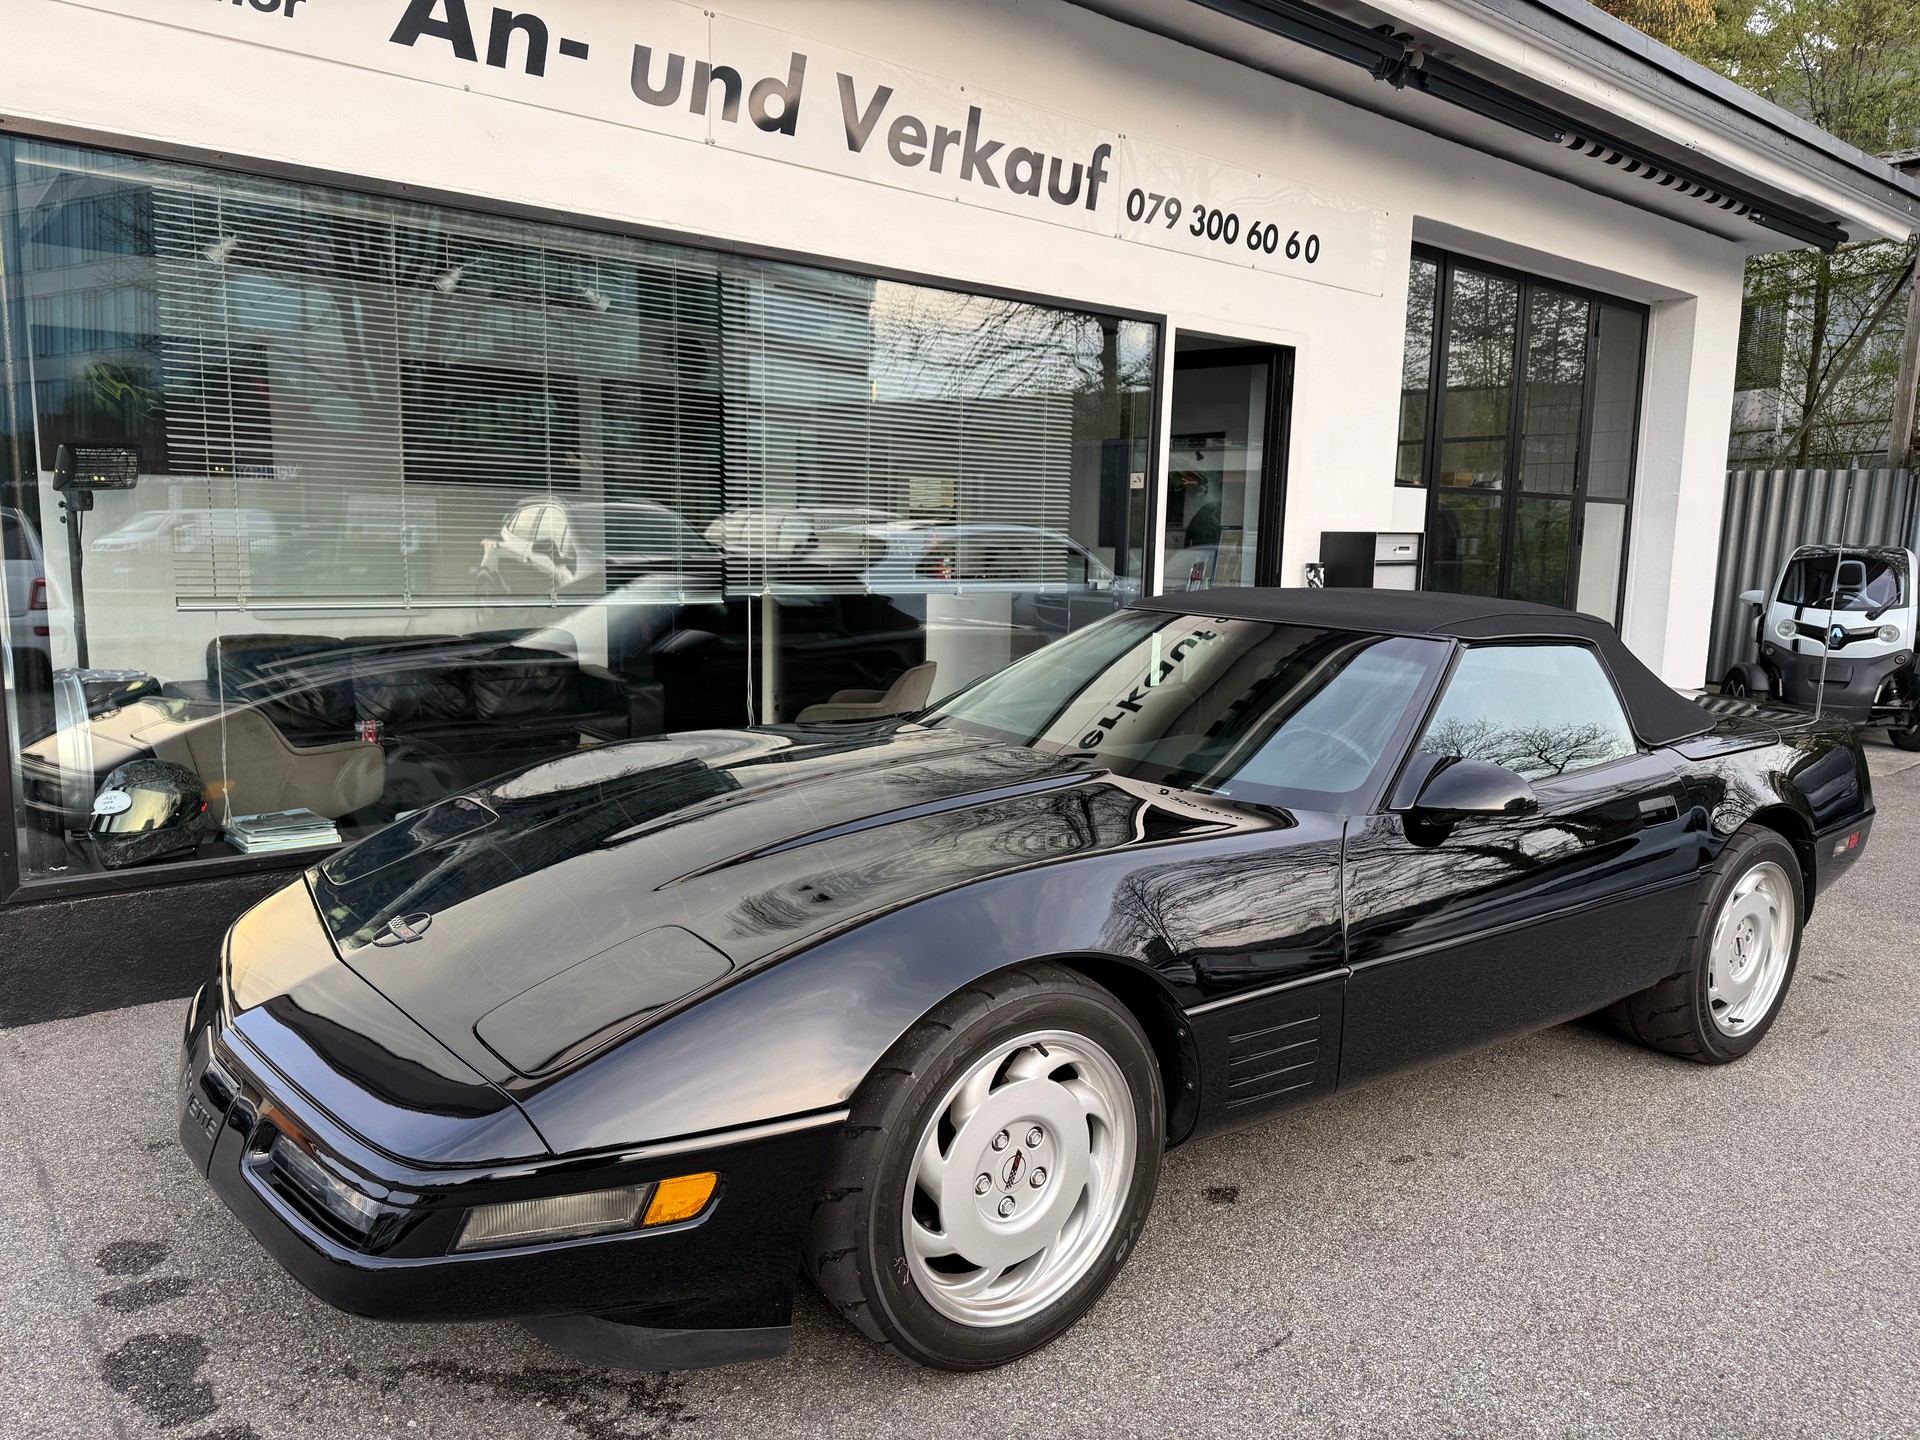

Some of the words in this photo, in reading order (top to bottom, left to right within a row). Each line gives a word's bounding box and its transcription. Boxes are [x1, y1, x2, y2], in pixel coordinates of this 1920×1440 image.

[389, 0, 590, 77] An-
[630, 43, 807, 136] und
[836, 72, 1111, 211] Verkauf
[1126, 188, 1182, 230] 079
[1189, 204, 1240, 245] 300
[1246, 220, 1279, 254] 60
